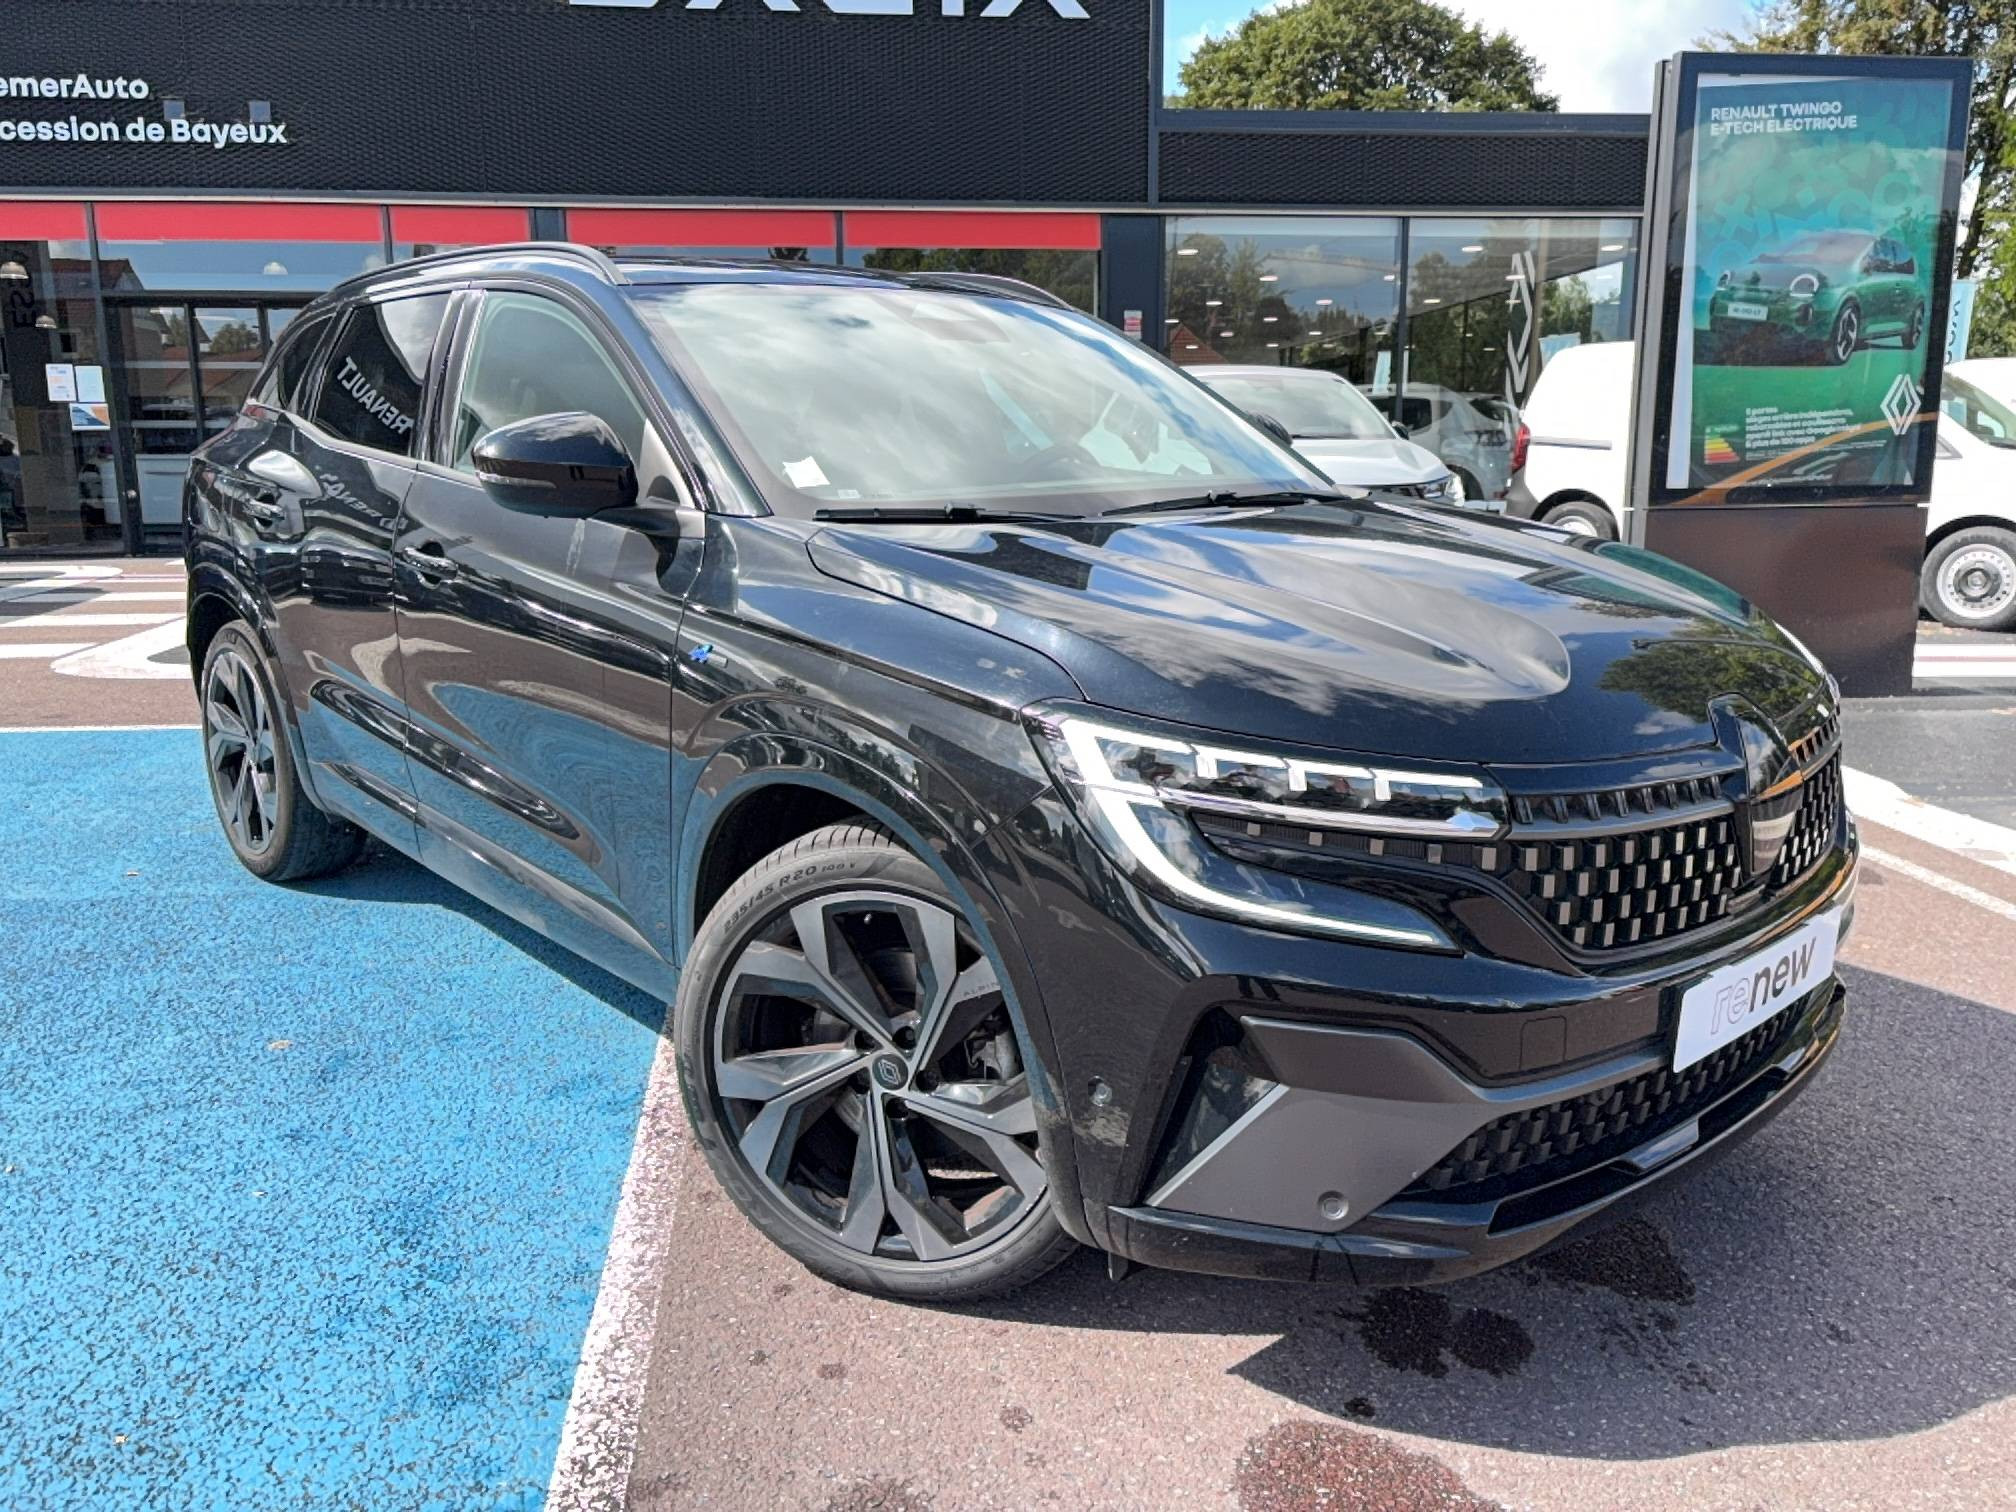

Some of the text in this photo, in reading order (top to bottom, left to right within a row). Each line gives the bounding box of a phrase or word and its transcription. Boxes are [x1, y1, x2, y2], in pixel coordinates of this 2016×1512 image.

[1711, 101, 1842, 121] RENAULT TWINGO
[0, 115, 288, 149] cession de Bayeux
[1710, 115, 1858, 136] E-TECH ELECTRIQUE
[1710, 936, 1817, 1035] renew
